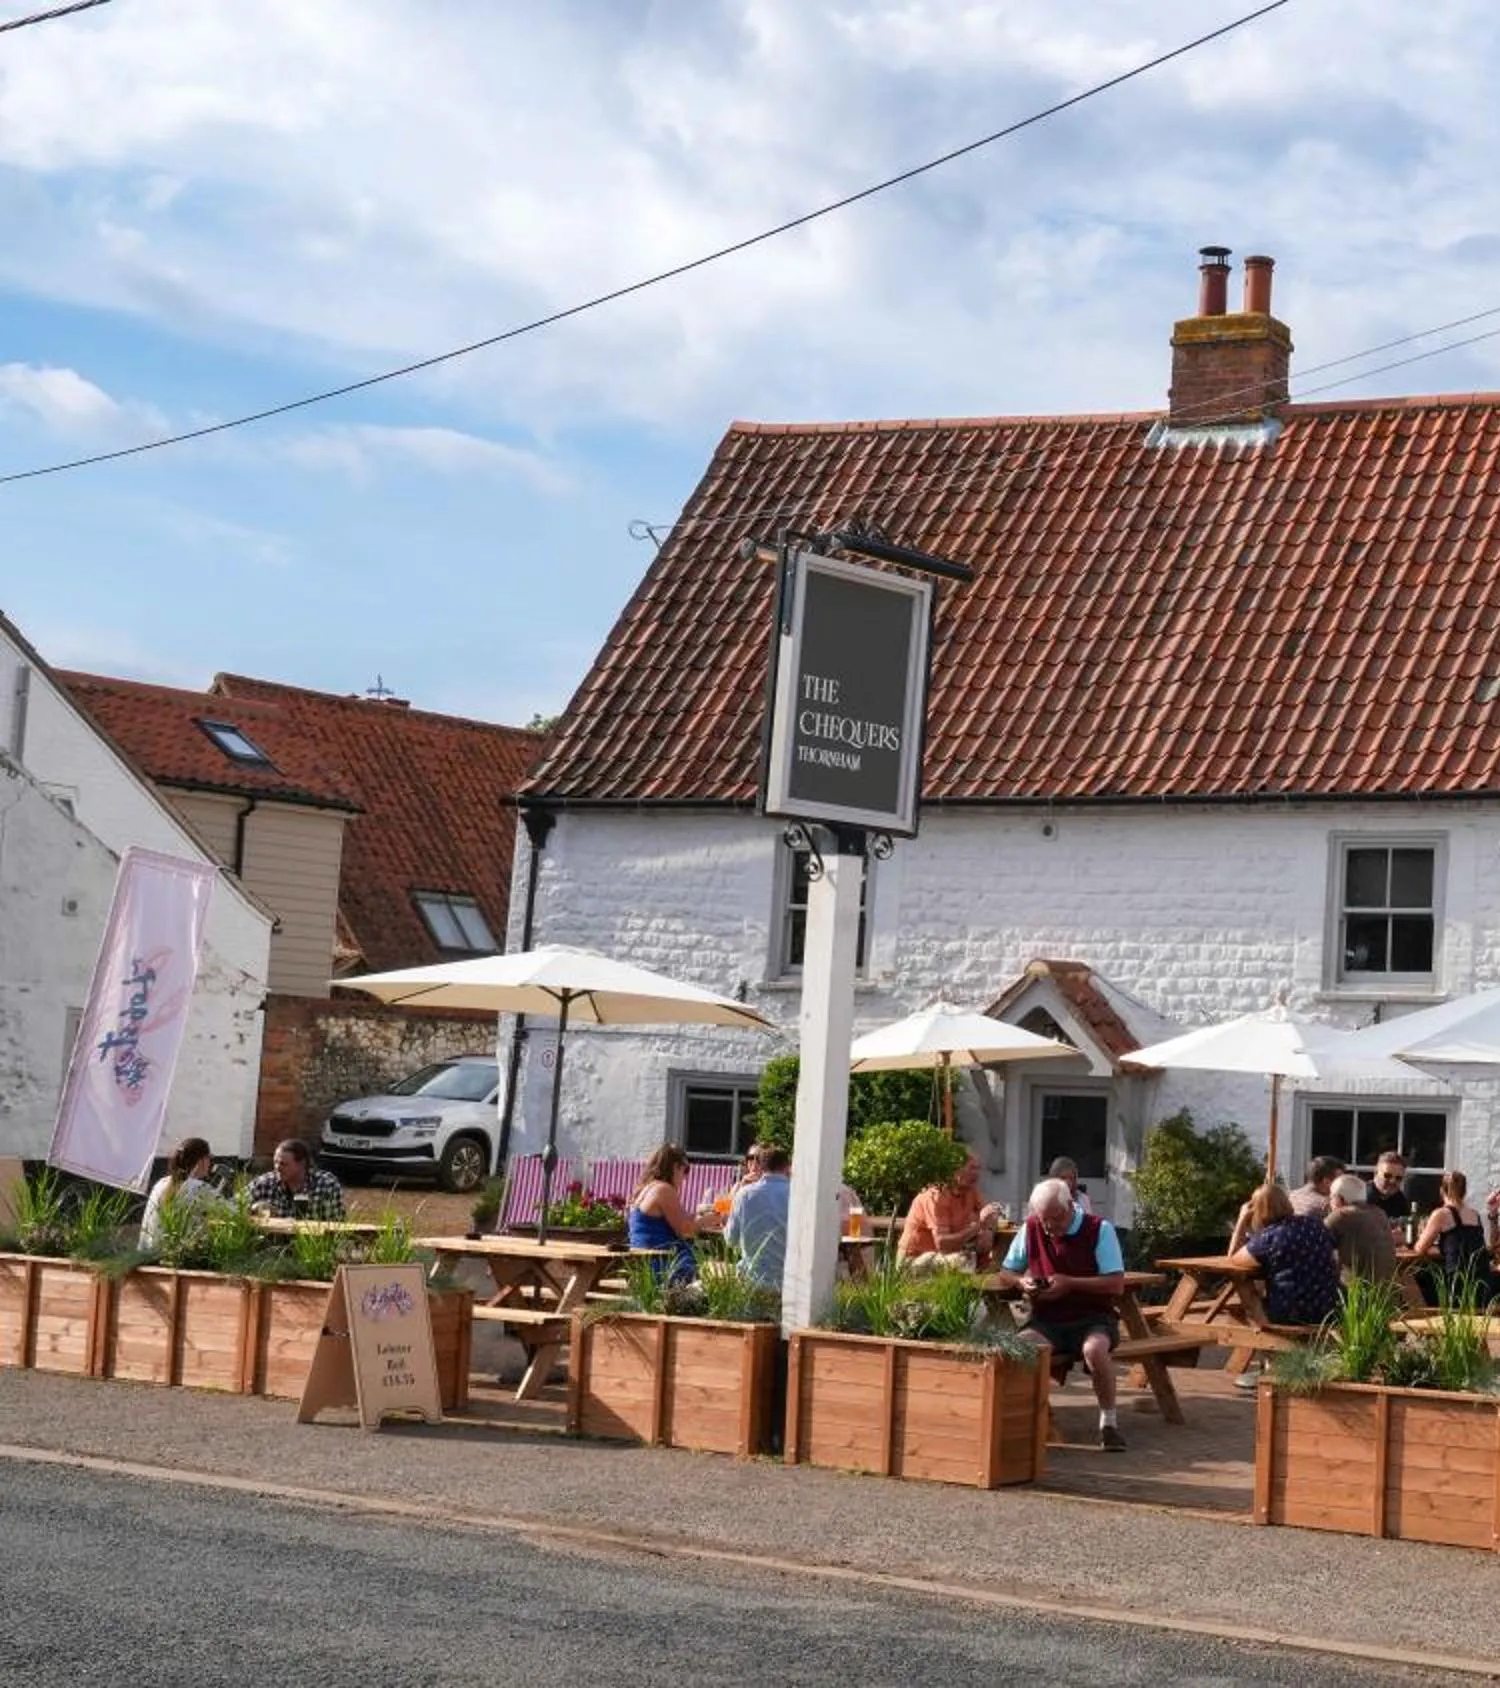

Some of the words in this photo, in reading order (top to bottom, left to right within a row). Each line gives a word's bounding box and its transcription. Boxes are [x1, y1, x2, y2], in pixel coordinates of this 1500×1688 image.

[803, 675, 841, 704] THE
[799, 711, 900, 751] CHEQUERS
[797, 744, 861, 772] THORNHAM
